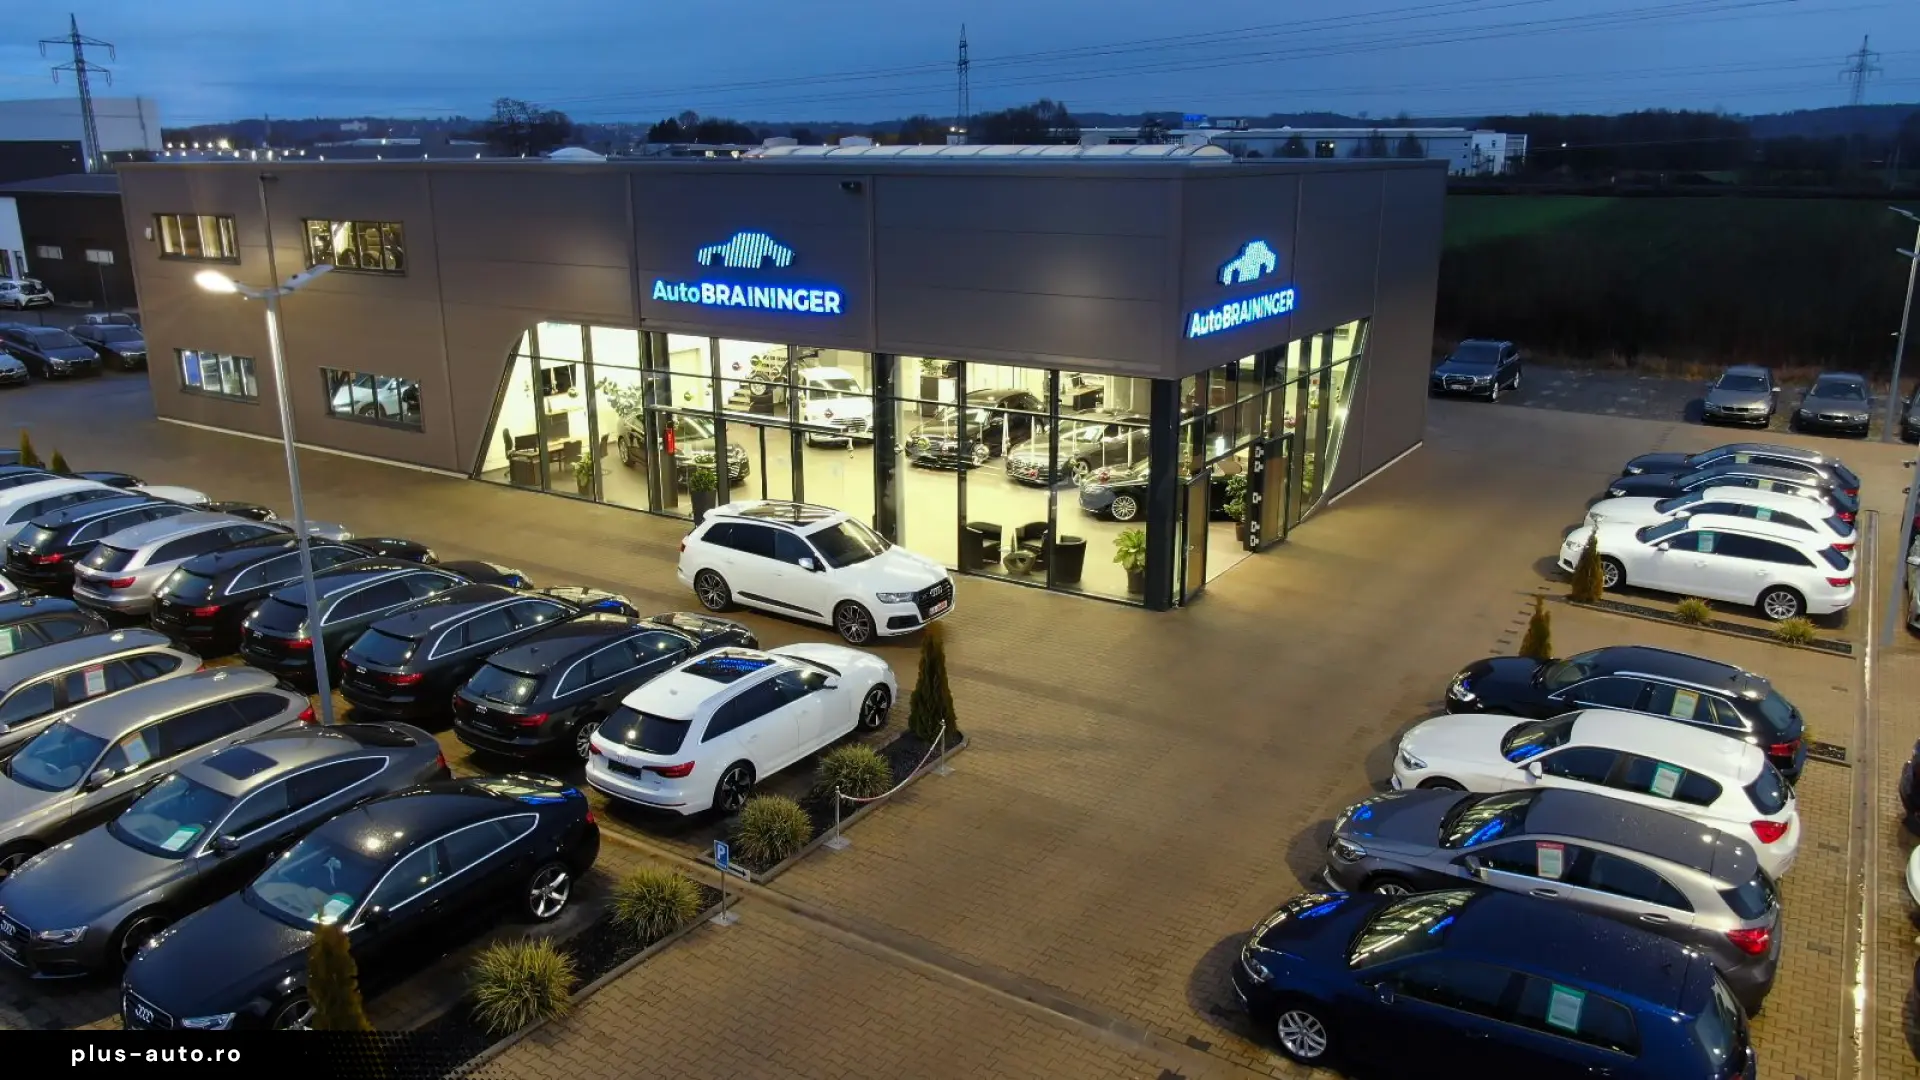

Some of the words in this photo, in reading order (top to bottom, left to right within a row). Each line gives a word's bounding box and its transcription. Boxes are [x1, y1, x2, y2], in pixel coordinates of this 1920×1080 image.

[653, 280, 841, 313] AutoBRAININGER
[1190, 288, 1294, 338] AutoBRAININGER
[717, 844, 726, 860] P
